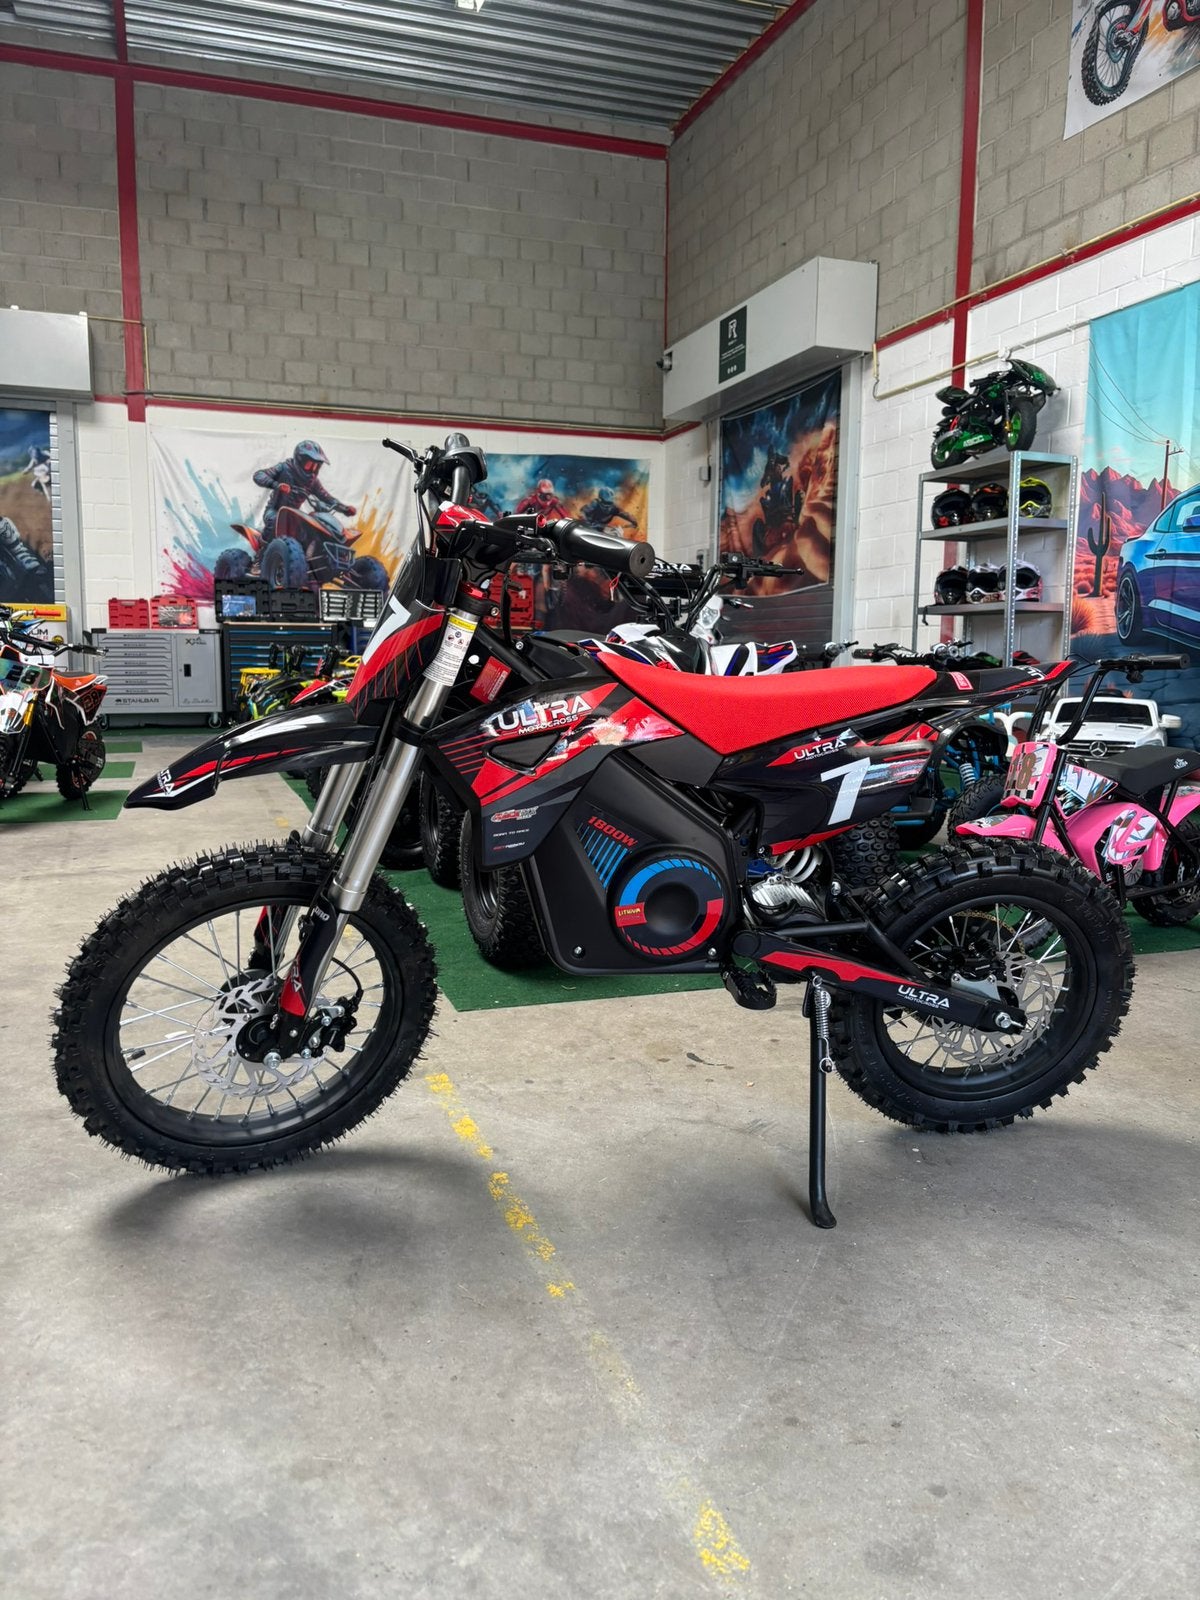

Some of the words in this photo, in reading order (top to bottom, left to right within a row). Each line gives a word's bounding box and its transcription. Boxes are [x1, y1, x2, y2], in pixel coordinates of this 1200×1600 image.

[362, 594, 411, 666] 7
[497, 695, 592, 730] ULTRA
[518, 714, 579, 736] MOTOCROSS
[794, 738, 847, 760] ULTRA
[820, 757, 871, 826] 7
[587, 816, 639, 848] 1800W
[898, 984, 950, 1008] ULTRA
